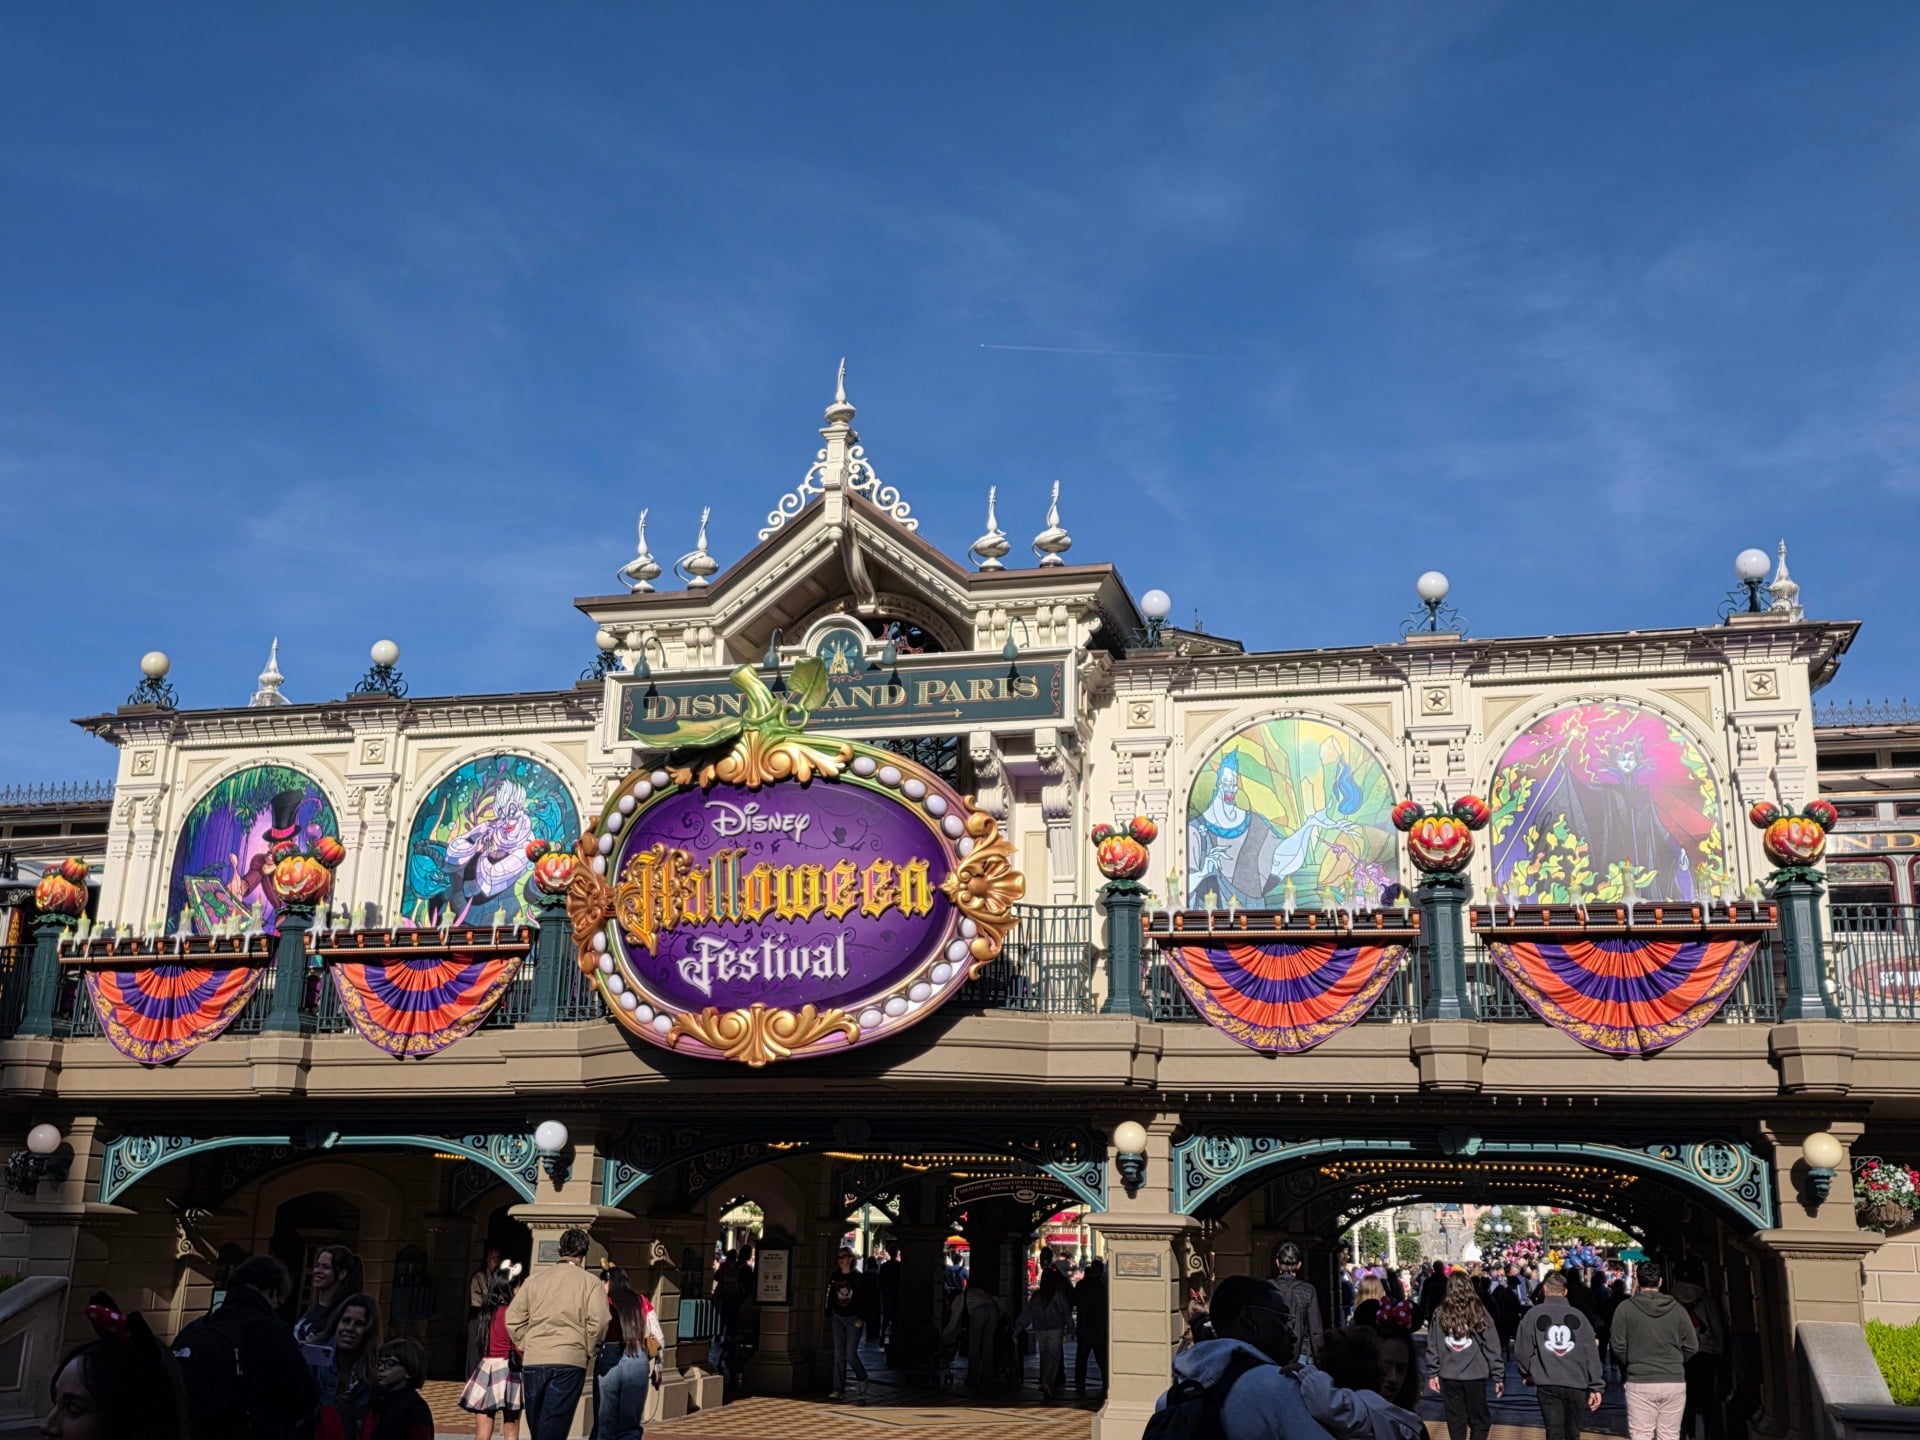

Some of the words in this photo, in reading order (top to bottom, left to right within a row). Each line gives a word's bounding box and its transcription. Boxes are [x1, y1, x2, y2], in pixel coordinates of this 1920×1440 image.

[643, 684, 907, 721] DISNYAND
[914, 675, 1039, 708] PARIS
[705, 801, 810, 843] Disney
[615, 842, 936, 957] Halloween
[676, 931, 850, 998] Festival
